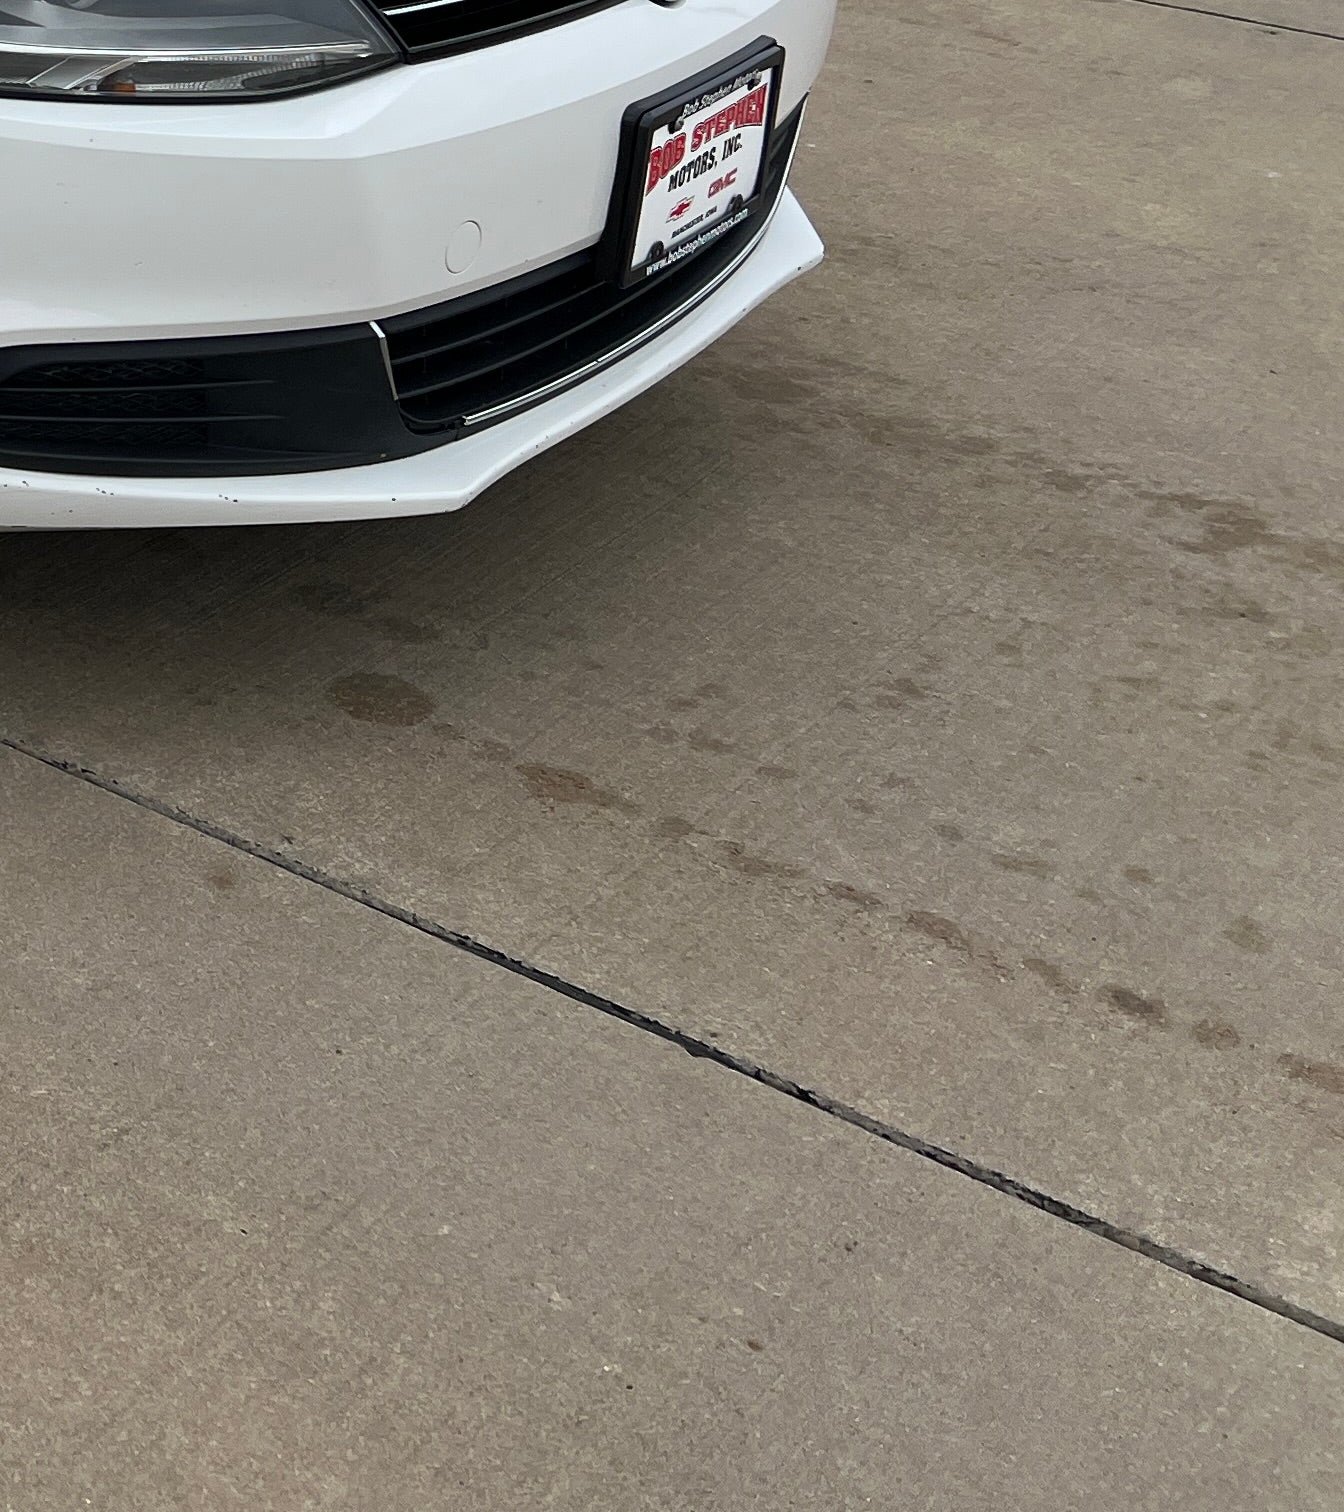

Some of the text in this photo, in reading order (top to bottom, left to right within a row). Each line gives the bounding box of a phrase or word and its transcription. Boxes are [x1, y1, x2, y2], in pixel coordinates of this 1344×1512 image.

[683, 98, 700, 117] Bob
[644, 82, 769, 197] BOB STEPHEN
[721, 133, 743, 161] INC.
[707, 167, 738, 199] GMC
